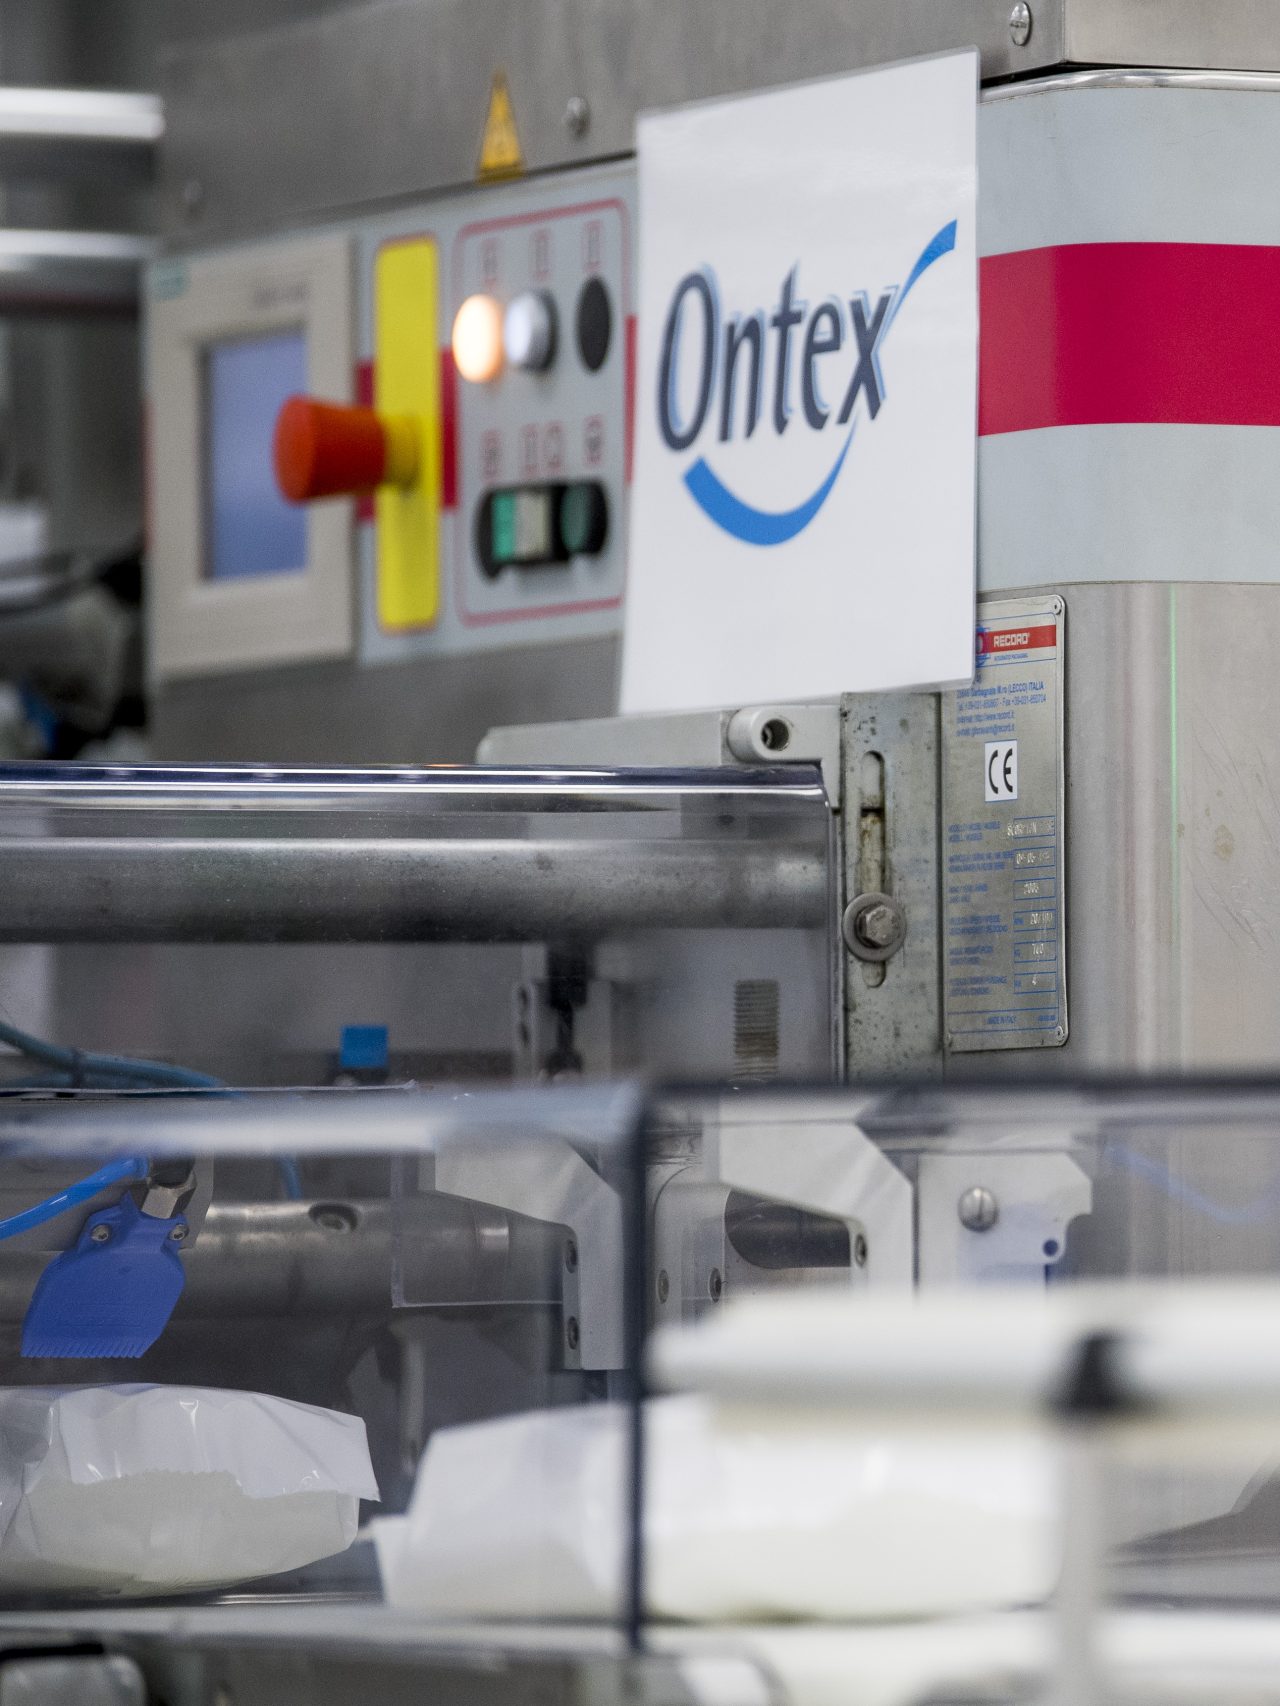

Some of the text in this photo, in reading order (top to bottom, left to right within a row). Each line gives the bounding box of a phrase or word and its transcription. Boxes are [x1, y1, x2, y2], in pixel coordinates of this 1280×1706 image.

[656, 260, 900, 453] Ontex
[993, 632, 1029, 648] RECORD
[988, 747, 1014, 795] CE
